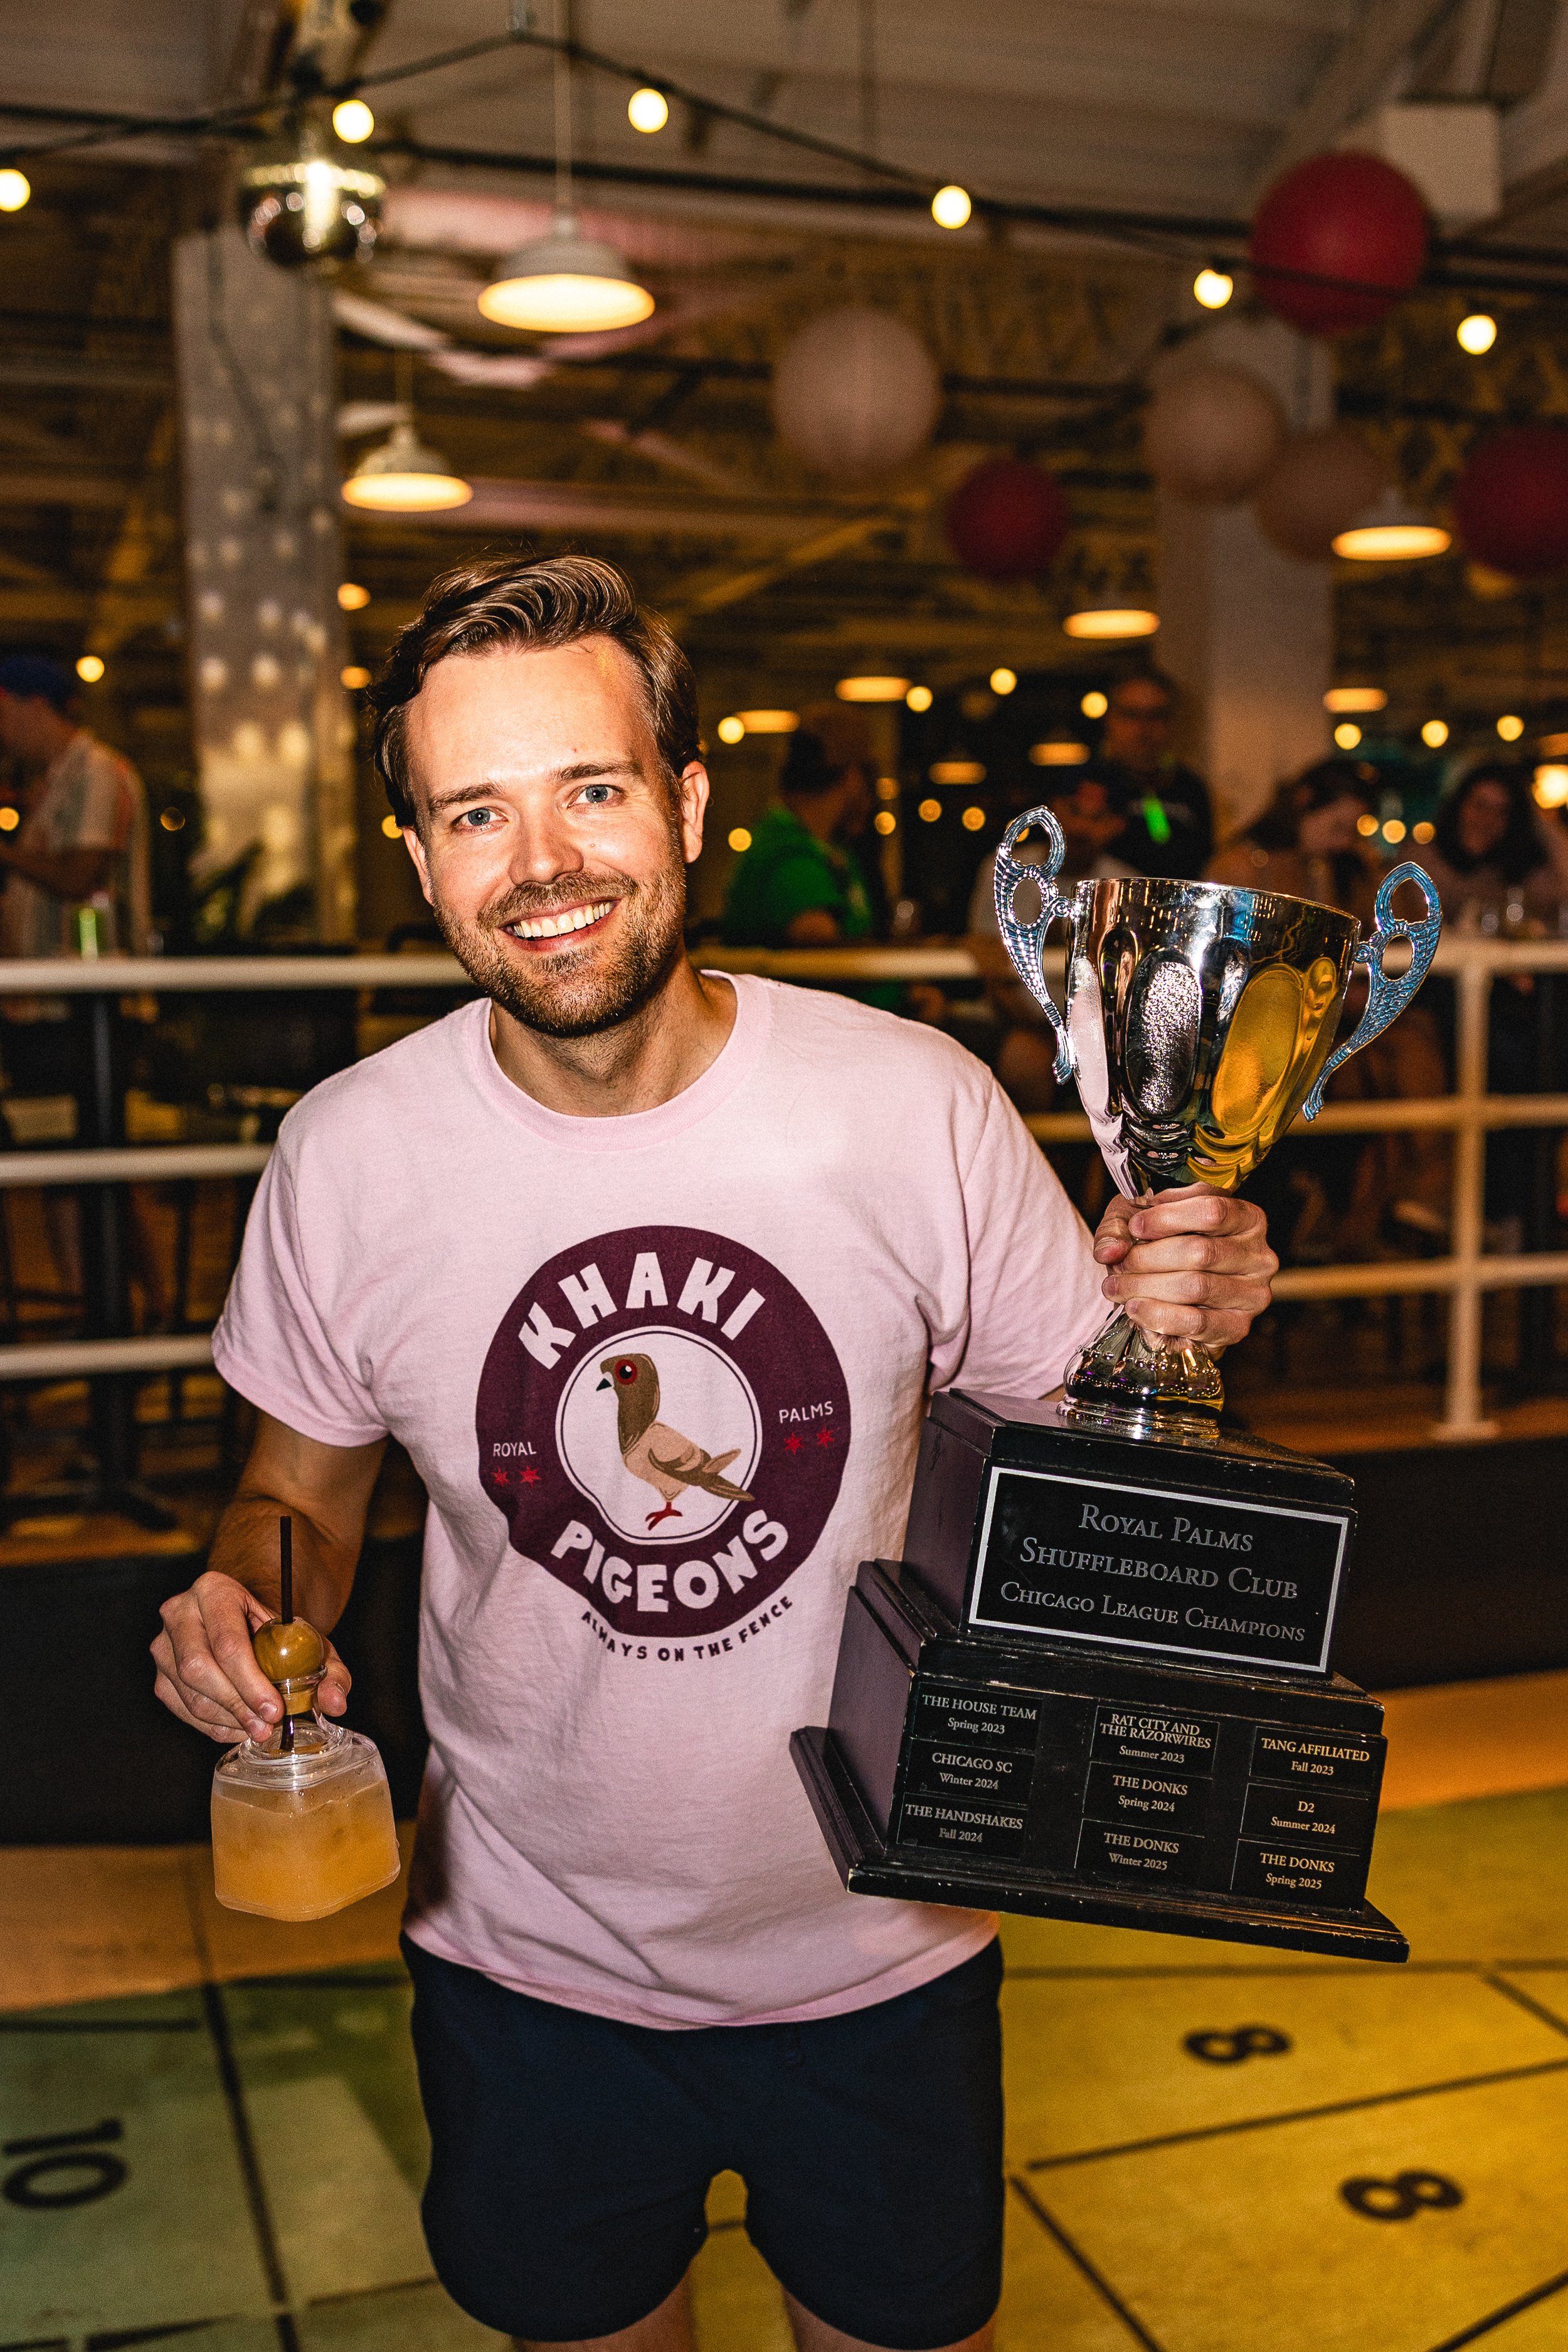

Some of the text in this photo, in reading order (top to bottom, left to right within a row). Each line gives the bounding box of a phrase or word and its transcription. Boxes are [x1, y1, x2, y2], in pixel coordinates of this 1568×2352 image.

[518, 1251, 766, 1370] KHAKI
[778, 1401, 834, 1424] PALMS
[492, 1441, 537, 1458] ROYAL
[550, 1510, 788, 1613] PIGEONS
[581, 1596, 793, 1661] ALWAYS ON THE FENCE
[922, 1694, 1037, 1720] THE HOUSE TEAM
[948, 1717, 1005, 1734] Spring 2023
[1111, 1714, 1200, 1735] RAT CITY AND
[1100, 1723, 1211, 1749] THE RAZORWIRES
[1119, 1745, 1185, 1764] Summer 2023
[1261, 1737, 1370, 1761] TANG AFFILIATED
[932, 1752, 1012, 1773] CHICAGO SC
[1291, 1761, 1334, 1776] Fall 2023
[940, 1772, 999, 1790] Winter 2024
[1112, 1775, 1188, 1796] THE DONKS
[1118, 1795, 1175, 1812] Spring 2024
[1298, 1801, 1315, 1813] D2
[905, 1804, 1024, 1830] THE HANDSHAKES
[1271, 1816, 1336, 1834] Summer 2024
[939, 1828, 983, 1843] Fall 2024
[1104, 1832, 1179, 1853] THE DONKS
[1108, 1852, 1168, 1870] Winter 2025
[1260, 1853, 1335, 1873] THE DONKS
[1266, 1873, 1322, 1889] Spring 2025
[1183, 2023, 1293, 2065] 8
[1, 2117, 130, 2210] 10
[1337, 2169, 1466, 2223] 8
